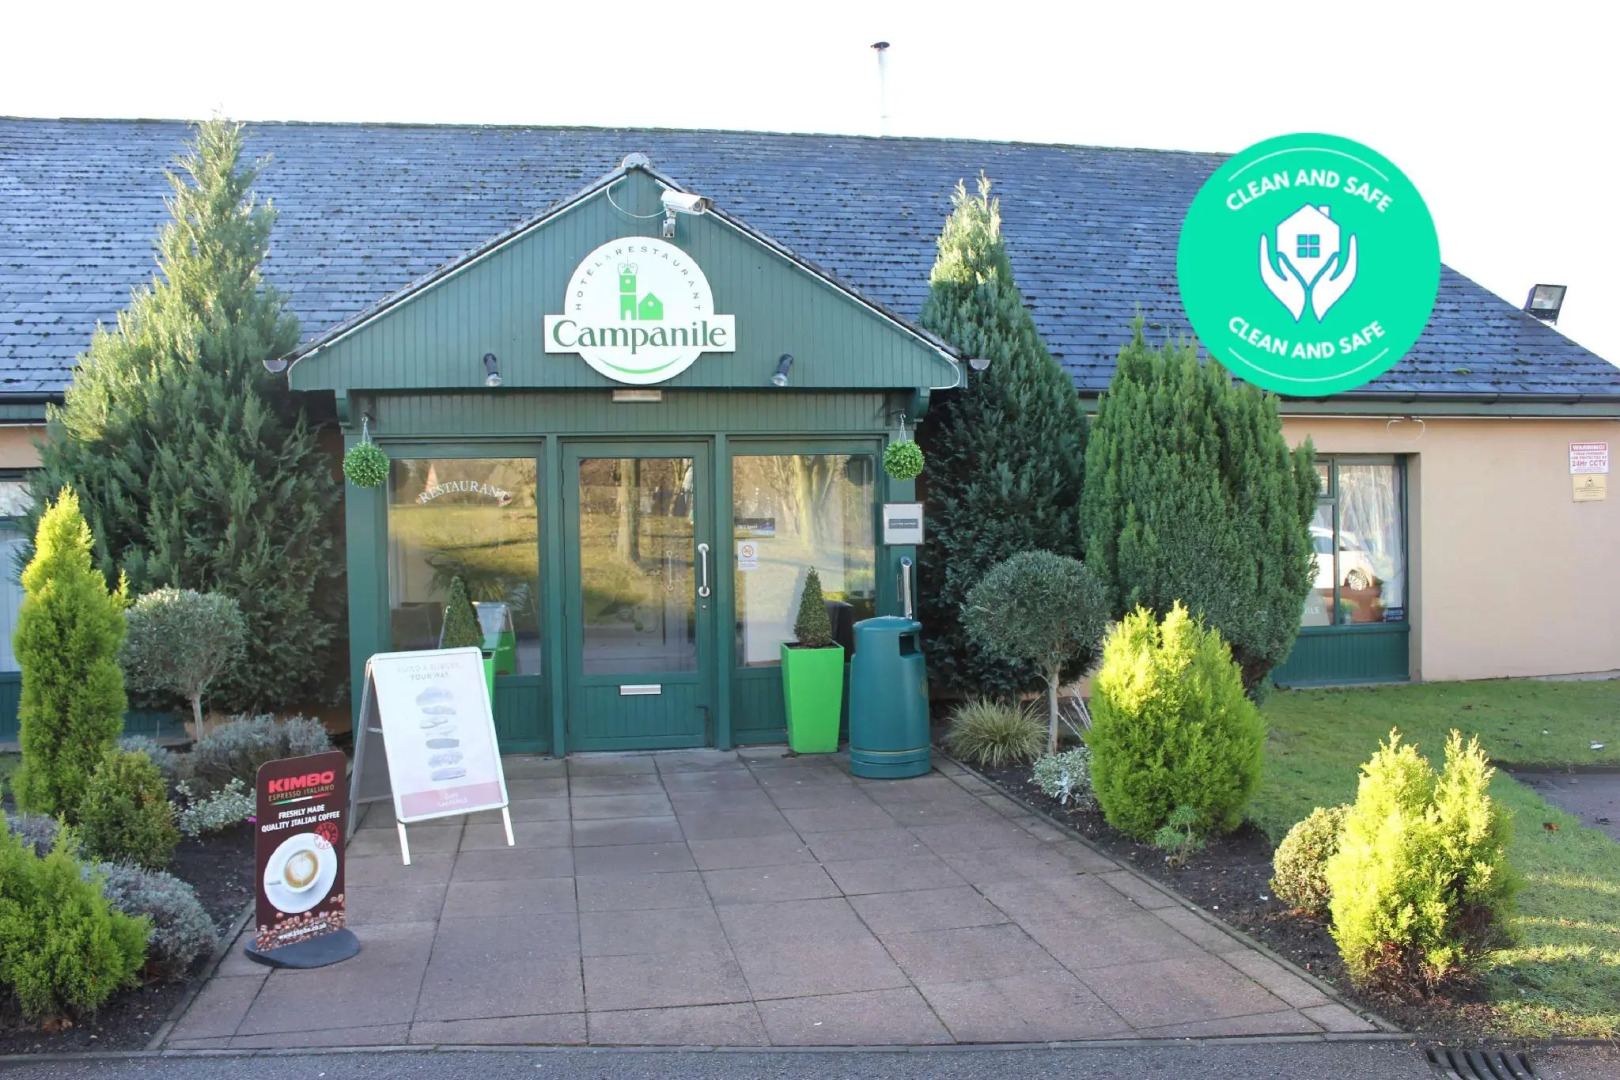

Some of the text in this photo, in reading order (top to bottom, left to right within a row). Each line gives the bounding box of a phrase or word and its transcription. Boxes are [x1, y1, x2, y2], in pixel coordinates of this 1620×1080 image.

[576, 261, 602, 311] HOTEL
[615, 246, 701, 311] RESTAURANT
[553, 319, 727, 355] Campanile
[418, 480, 512, 504] RESTAURANT
[268, 771, 334, 794] KIMBO
[268, 784, 335, 802] ESPRESSO ITALIANO
[261, 810, 340, 833] QUALITY ITALIAN COFFEE
[278, 804, 326, 819] FRESHLY MADE
